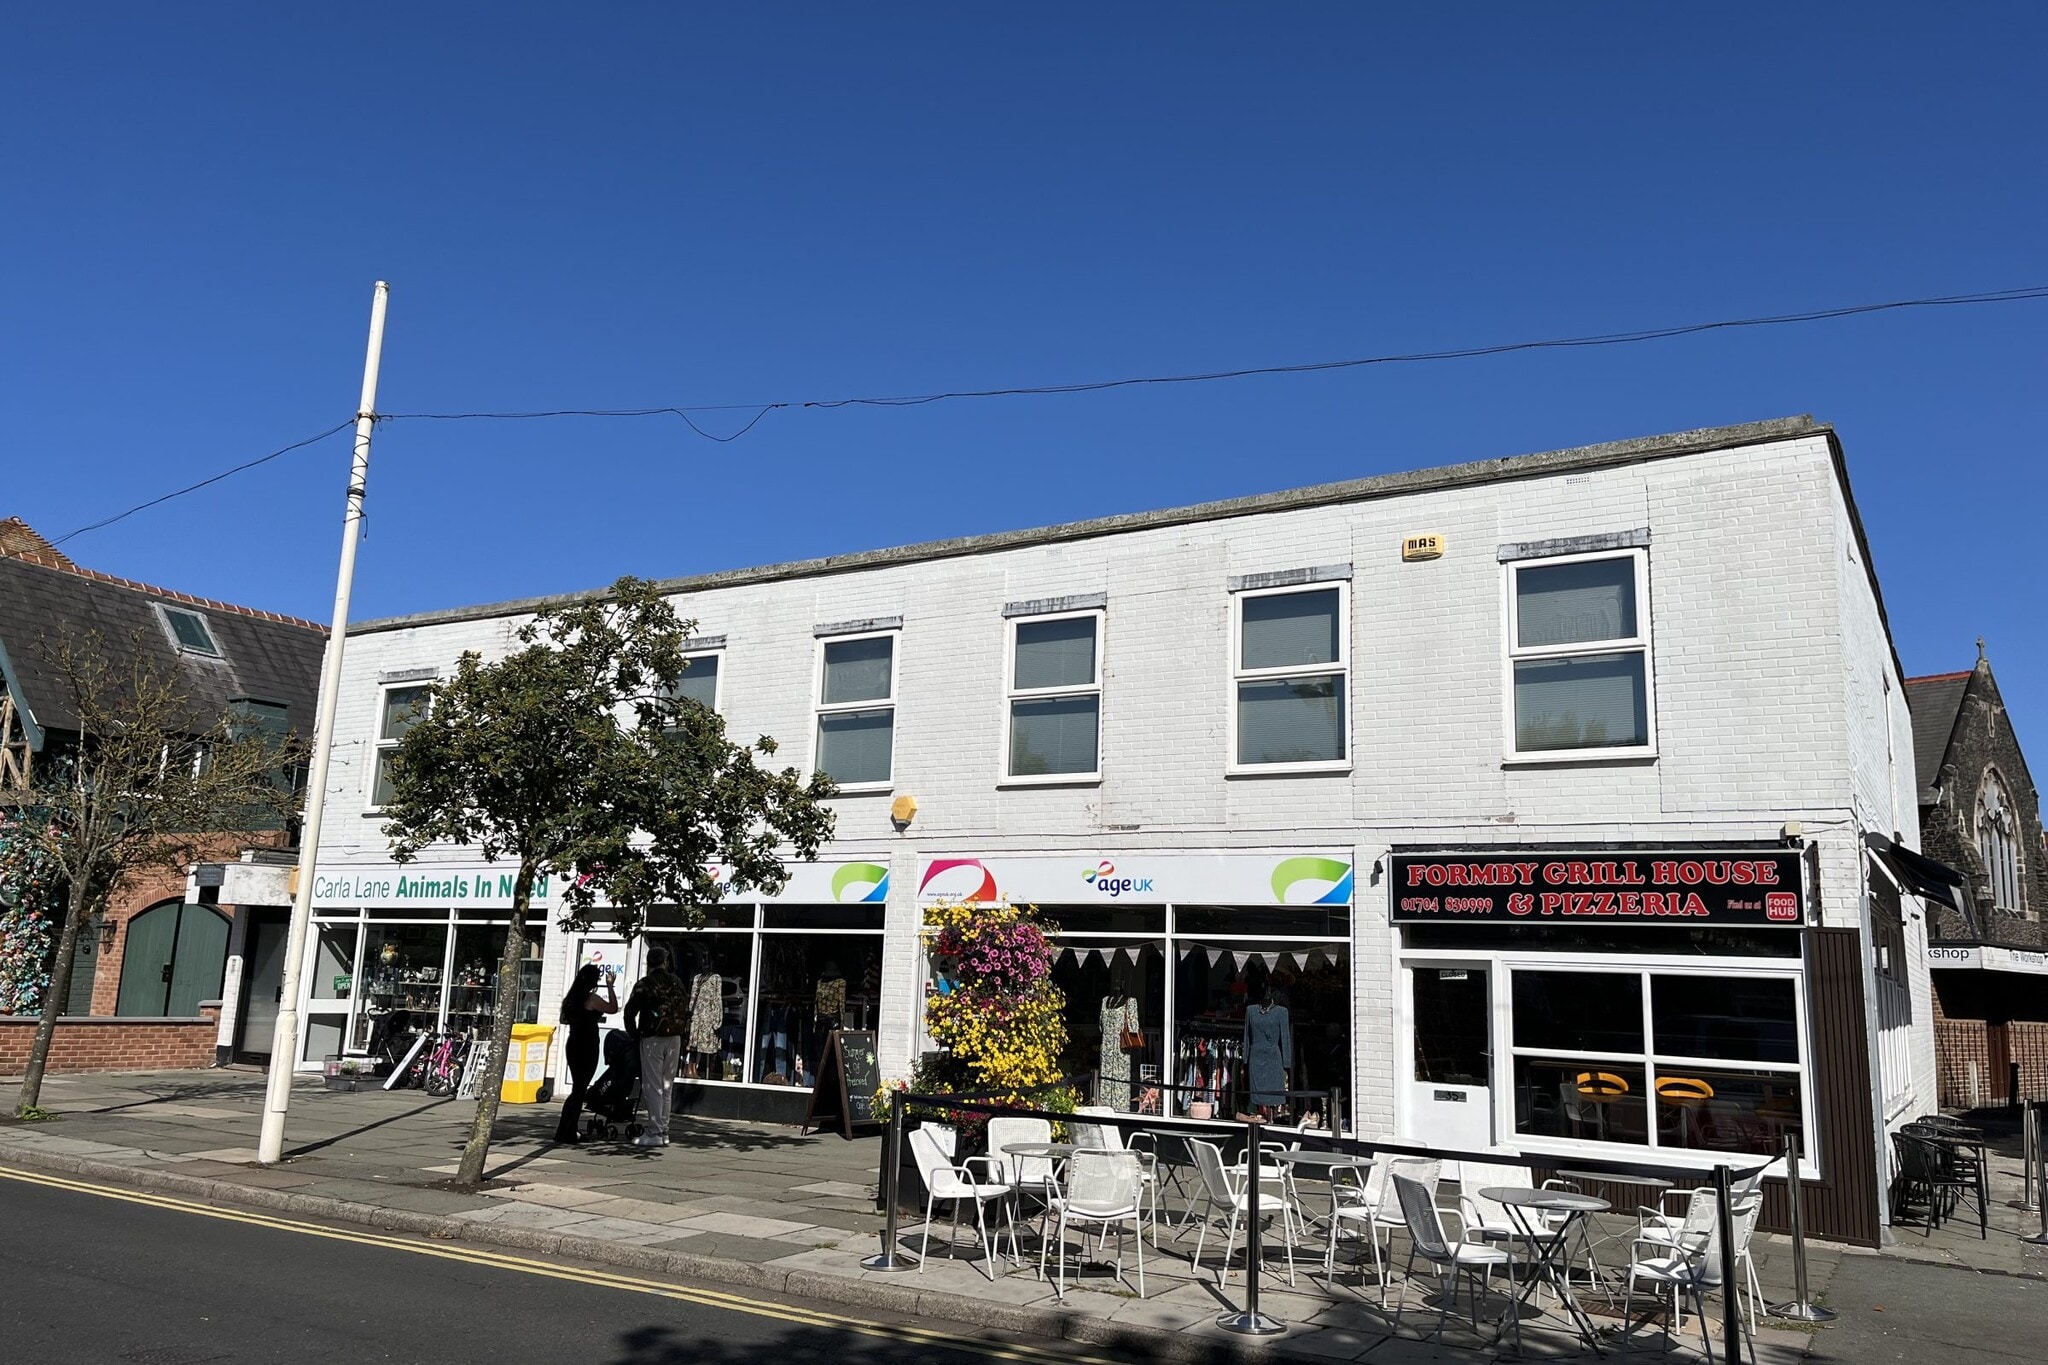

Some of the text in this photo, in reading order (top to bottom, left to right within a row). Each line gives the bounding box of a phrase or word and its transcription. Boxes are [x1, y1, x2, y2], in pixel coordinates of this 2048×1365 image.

[1408, 537, 1436, 550] MAS
[1407, 861, 1779, 886] FORMBY GRILL HOUSE
[315, 876, 351, 899] Carla
[355, 876, 390, 899] Lane
[395, 875, 468, 899] Animals
[474, 874, 493, 898] In
[1098, 878, 1153, 897] age UK
[1401, 897, 1493, 913] 01704 830999
[1507, 892, 1710, 917] & PIZZERIA
[1727, 899, 1743, 909] Find
[1768, 898, 1795, 907] FOOD
[1769, 906, 1795, 916] HUB
[1446, 1092, 1459, 1101] 35
